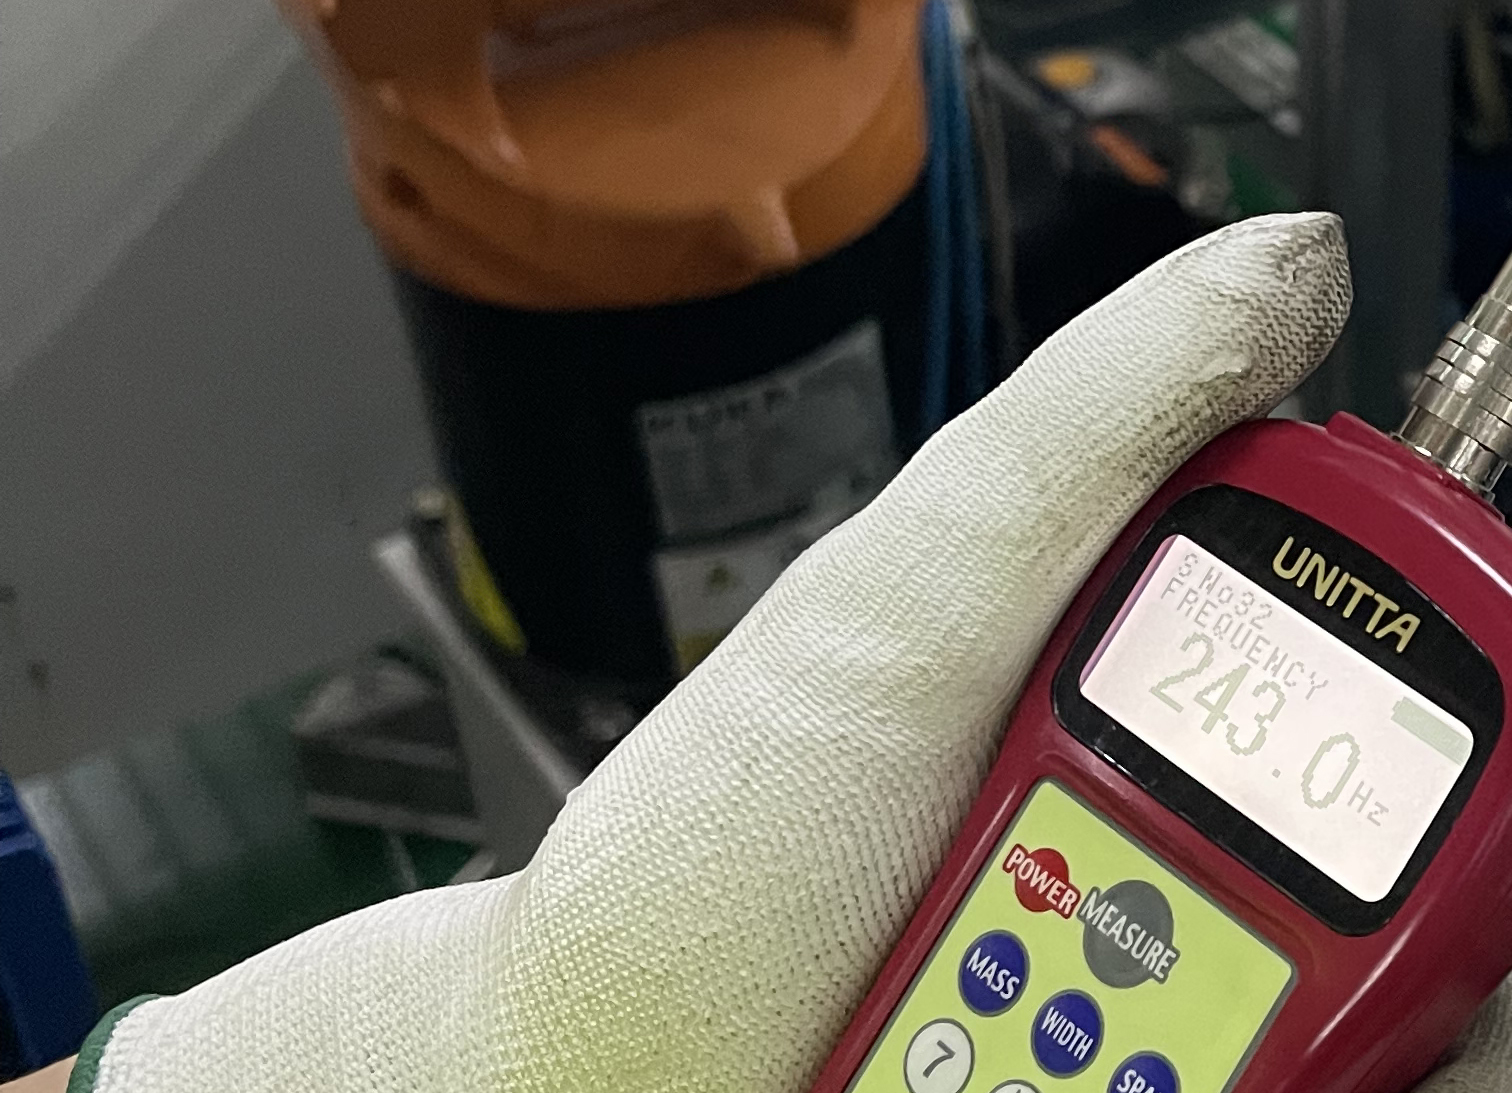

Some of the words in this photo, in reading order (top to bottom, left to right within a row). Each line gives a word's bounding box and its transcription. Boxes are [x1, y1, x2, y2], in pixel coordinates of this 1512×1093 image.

[1272, 536, 1421, 654] UNITTA
[1160, 576, 1329, 701] FREQUENCY
[1149, 631, 1361, 809] 243.0
[1346, 780, 1390, 827] Hz
[1006, 847, 1078, 916] POWER
[966, 947, 1020, 1000] MASS
[1080, 889, 1177, 979] MEASURE
[922, 1039, 956, 1078] 7
[1041, 1006, 1094, 1061] WIDTH
